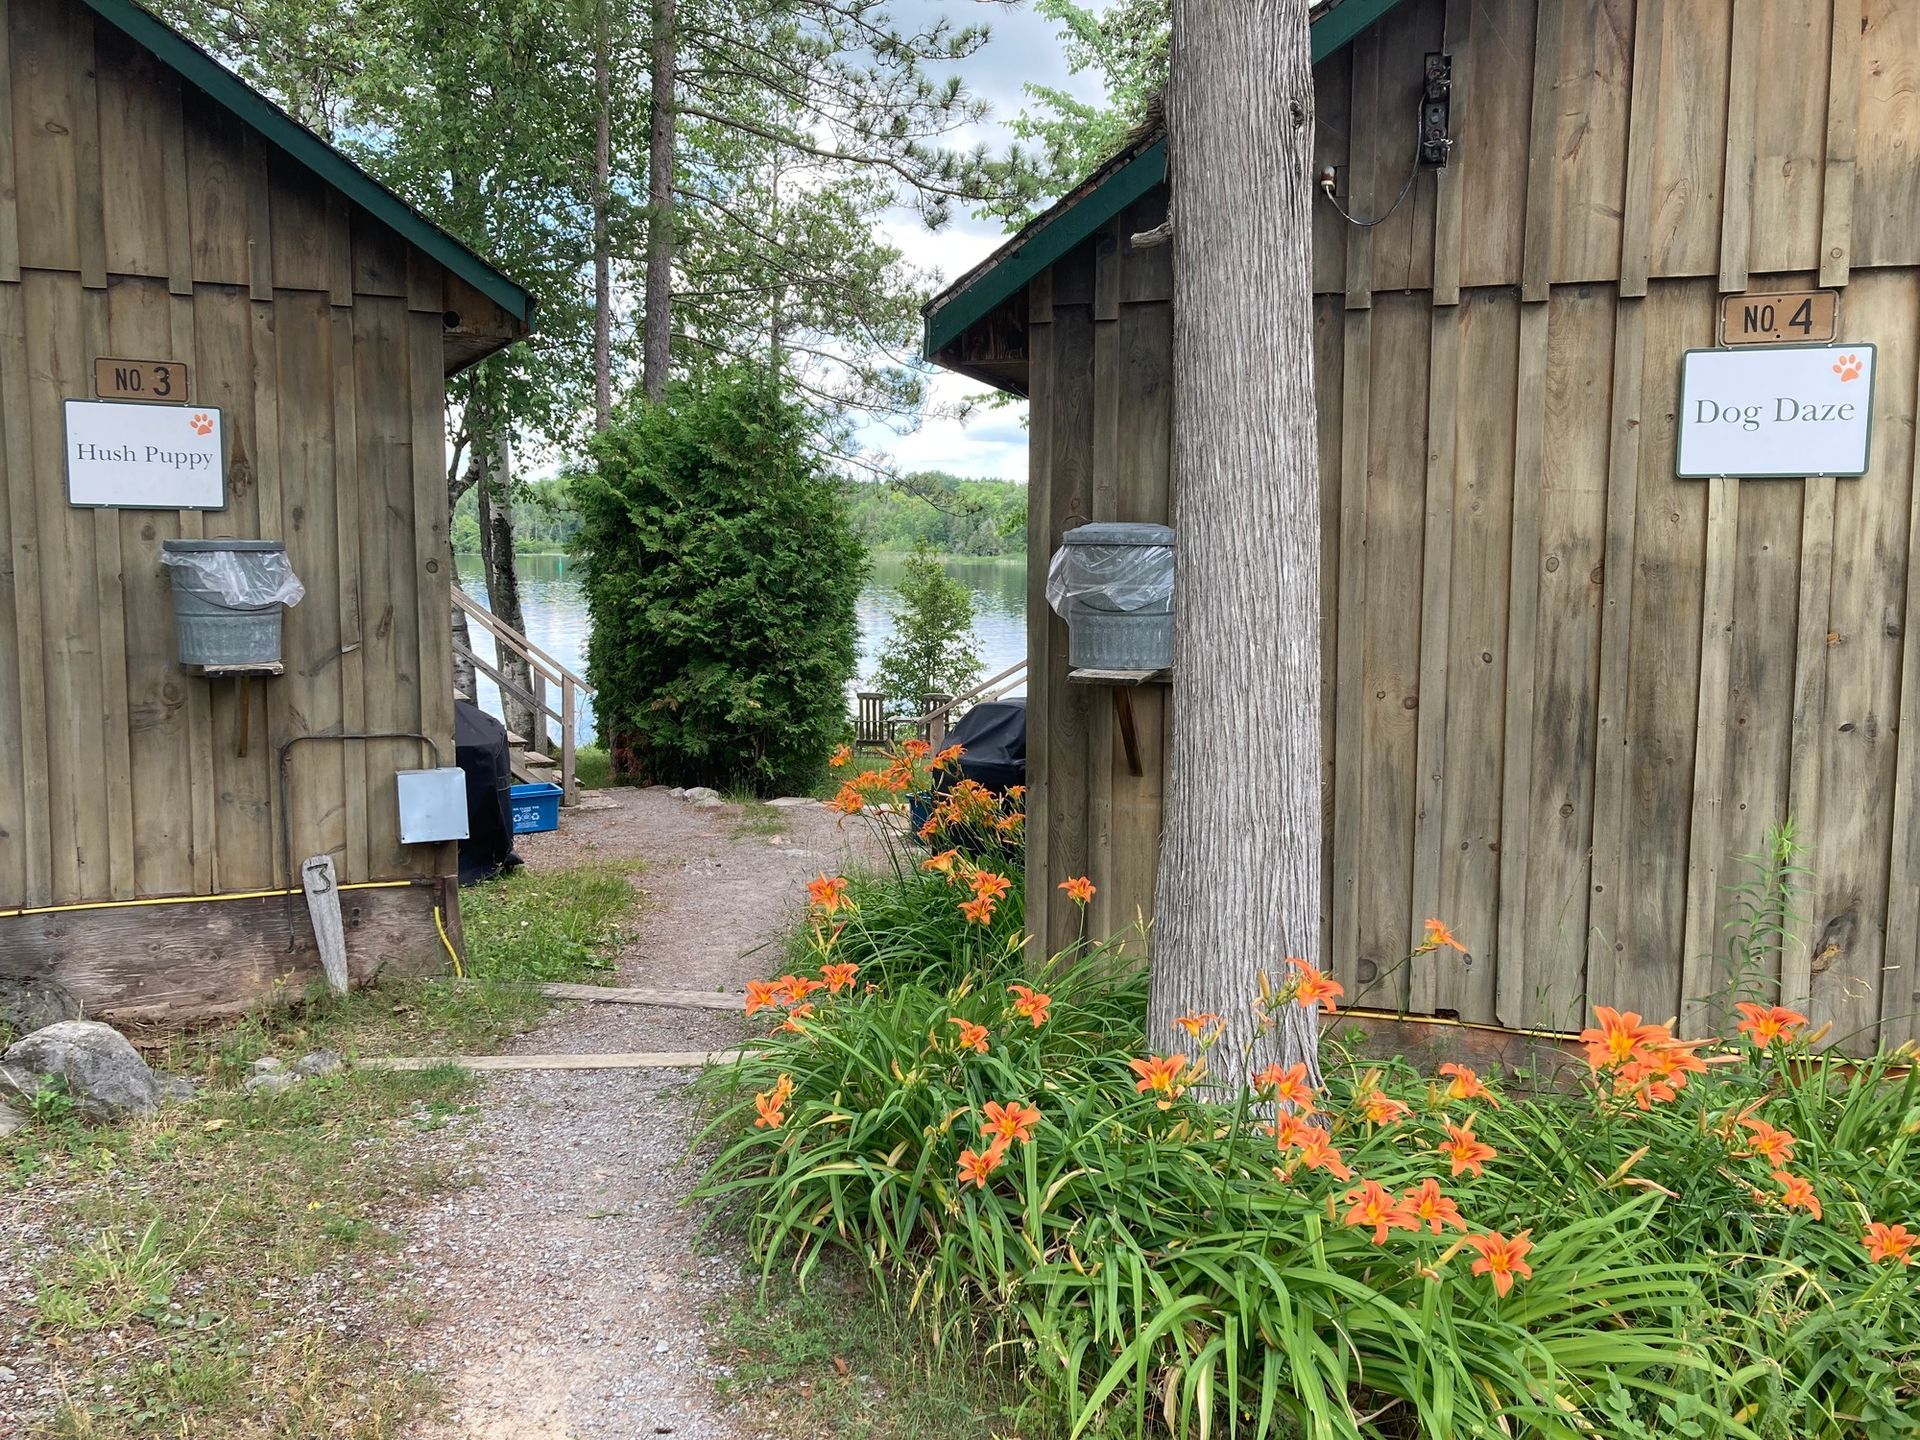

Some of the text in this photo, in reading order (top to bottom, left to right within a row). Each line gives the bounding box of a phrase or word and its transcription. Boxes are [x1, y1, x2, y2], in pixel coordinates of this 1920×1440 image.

[1743, 298, 1814, 335] NO. 4
[114, 366, 172, 396] NO. 3
[1694, 396, 1856, 432] Dog Daze
[76, 443, 214, 470] Hush Puppy
[307, 863, 331, 894] 3
